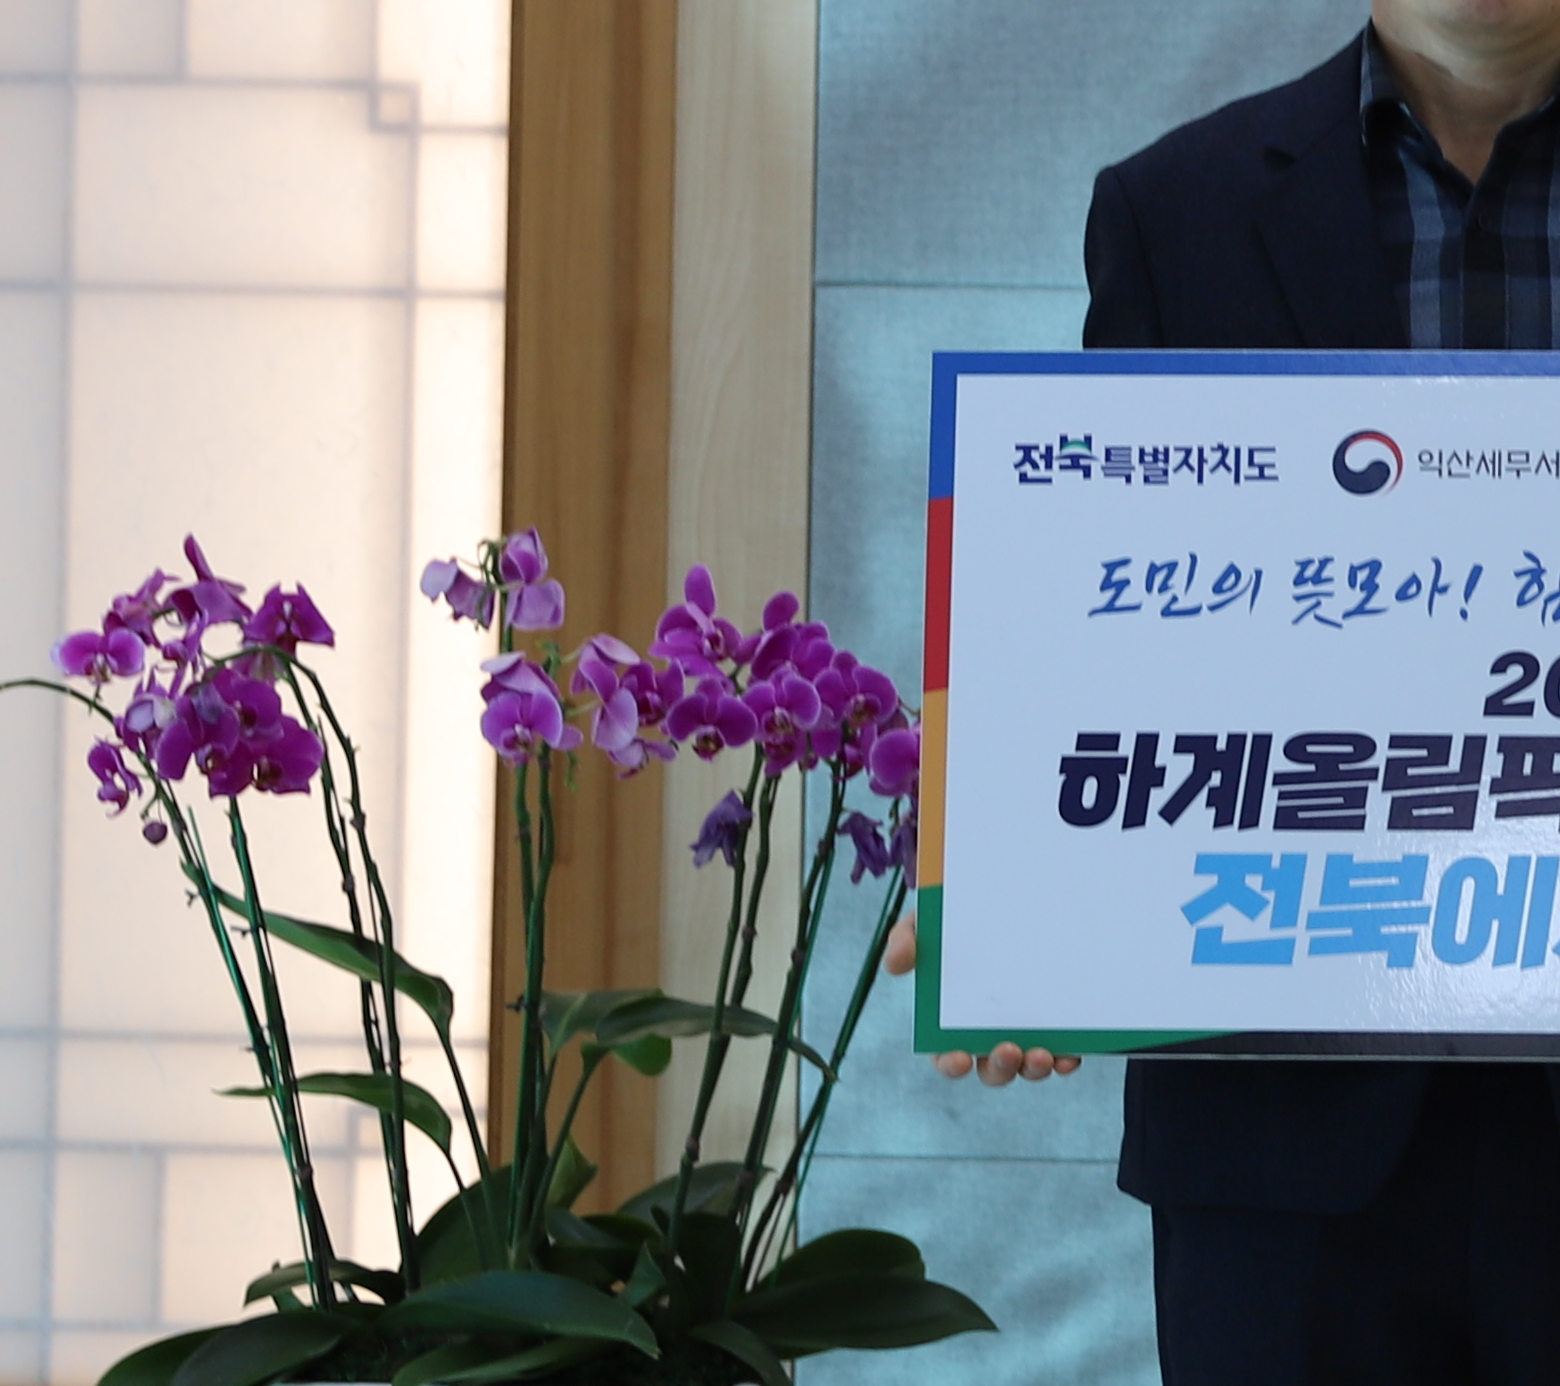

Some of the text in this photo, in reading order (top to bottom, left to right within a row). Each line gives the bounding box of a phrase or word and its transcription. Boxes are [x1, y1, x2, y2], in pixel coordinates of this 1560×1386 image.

[1014, 435, 1278, 484] 전북특별자치도
[1418, 450, 1559, 478] 익산세무서
[1088, 553, 1263, 618] 도민의
[1292, 557, 1483, 629] 뜻모아!
